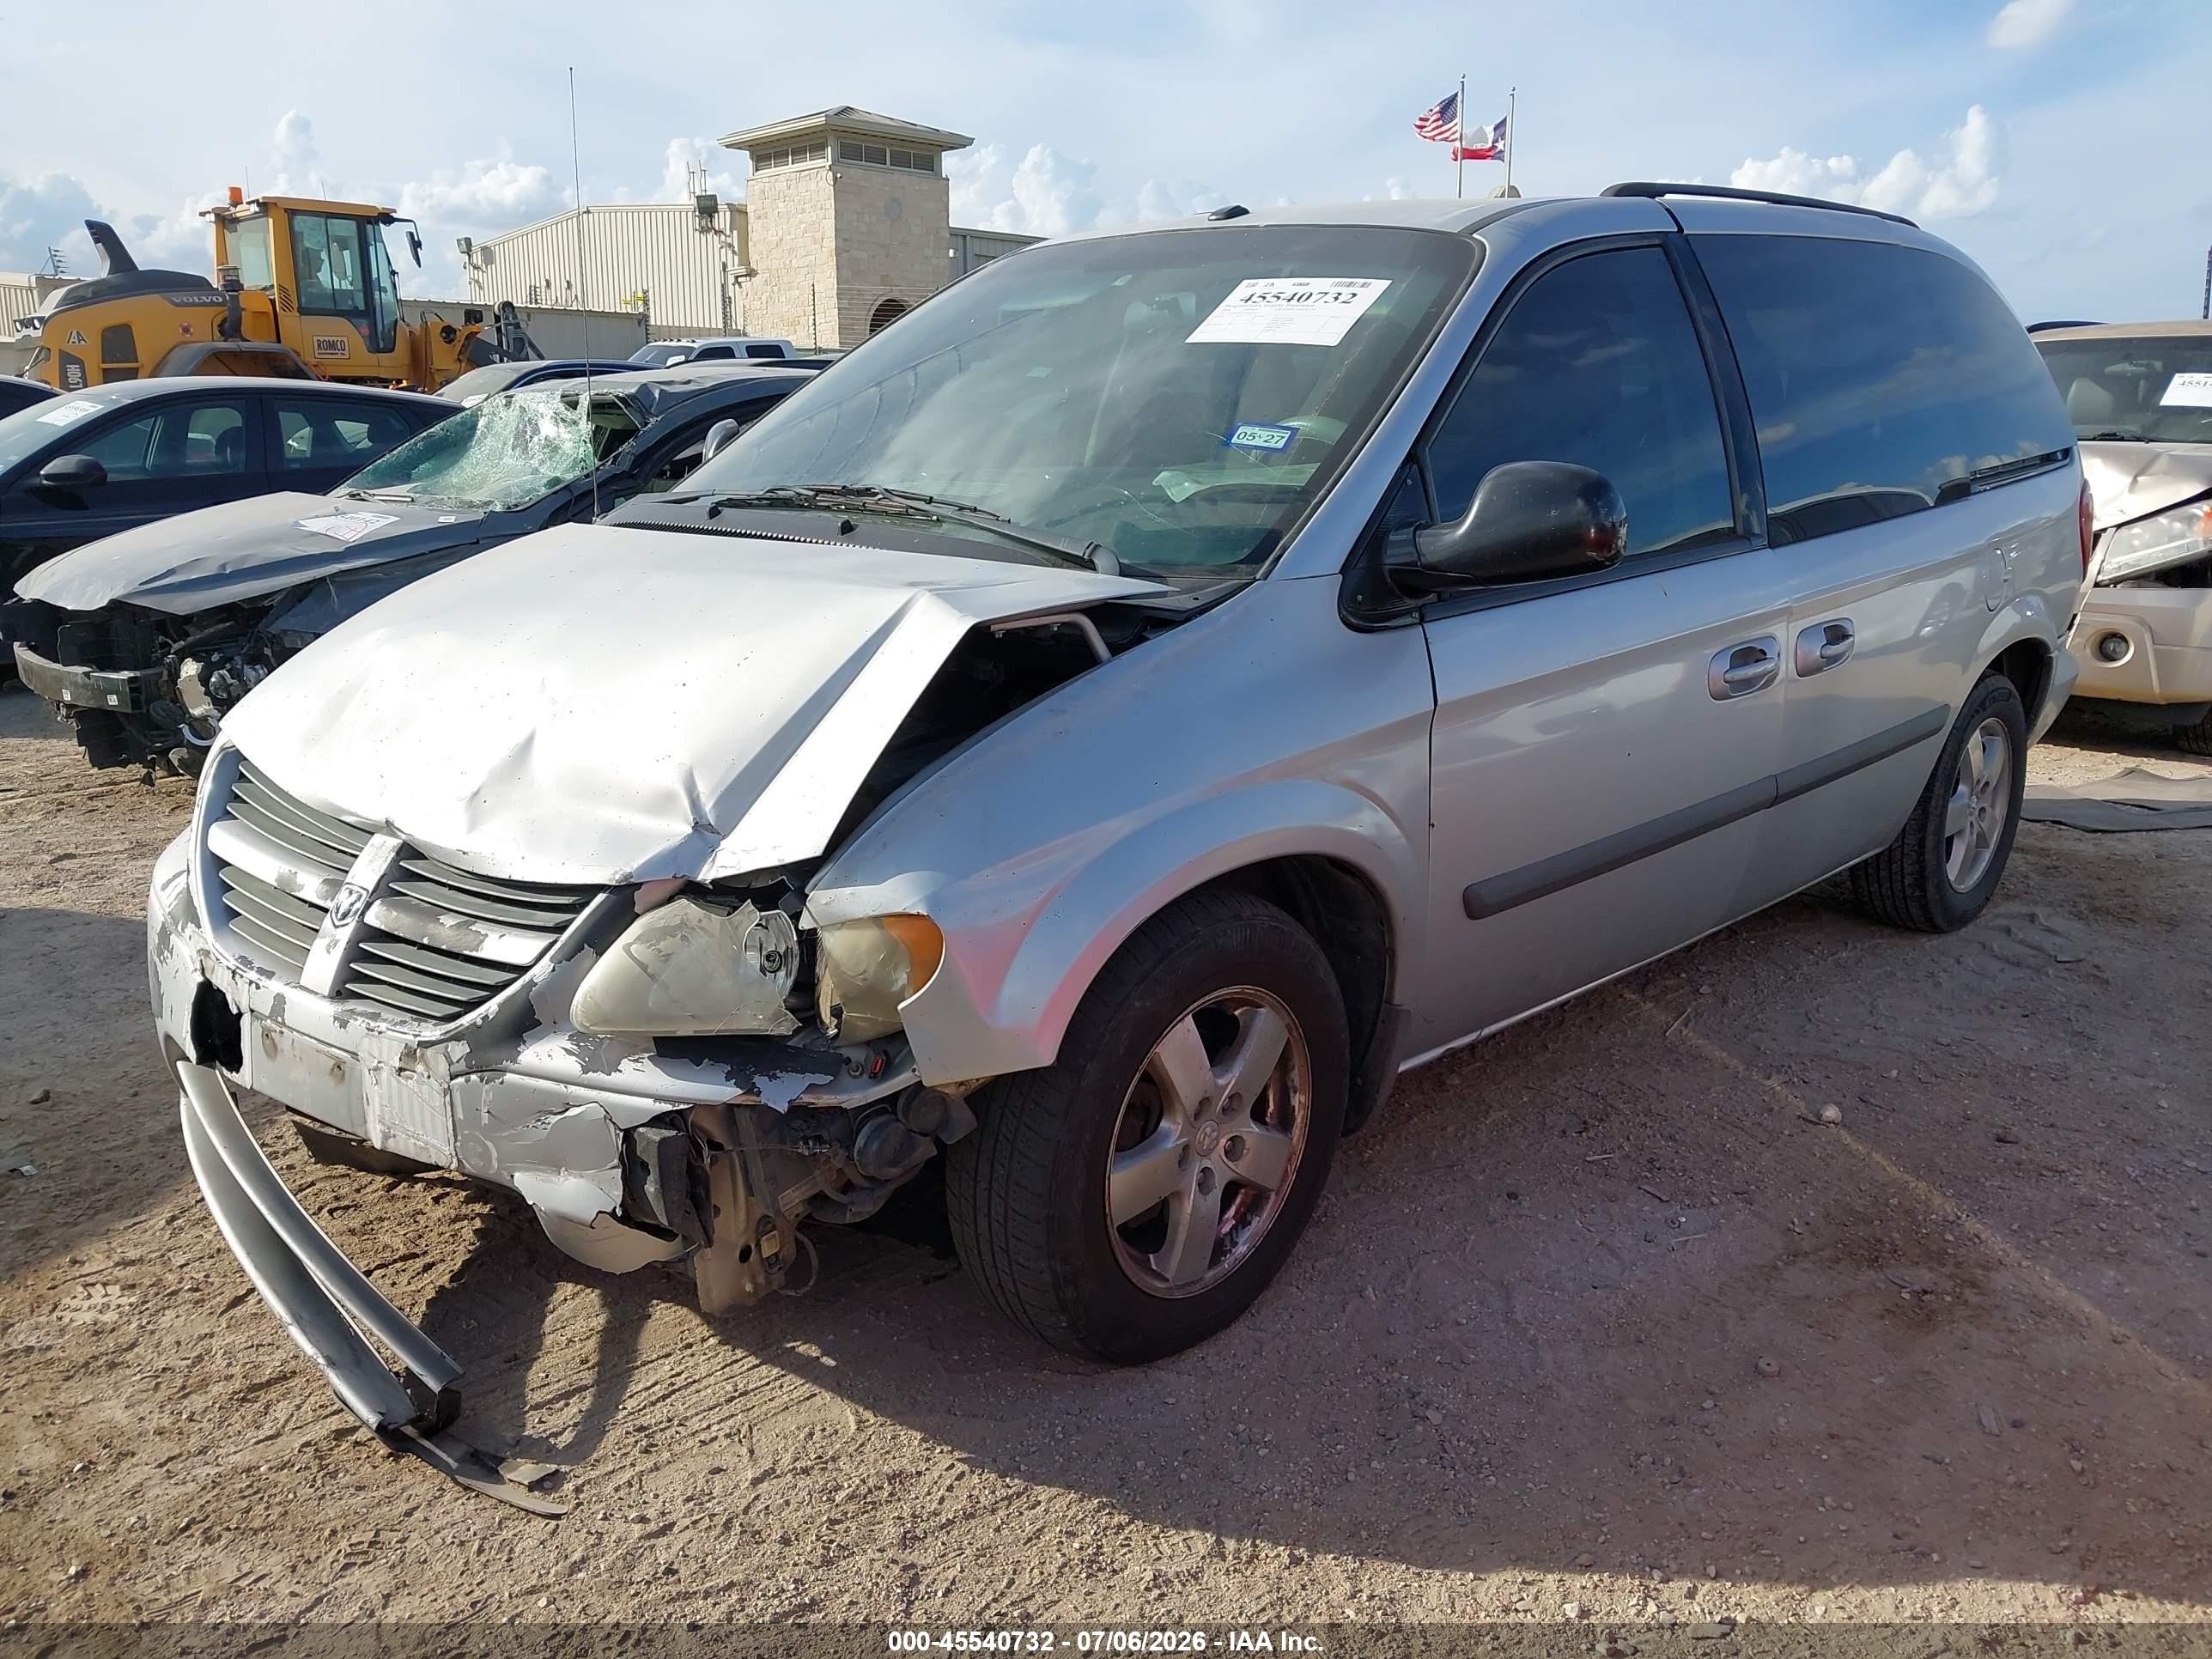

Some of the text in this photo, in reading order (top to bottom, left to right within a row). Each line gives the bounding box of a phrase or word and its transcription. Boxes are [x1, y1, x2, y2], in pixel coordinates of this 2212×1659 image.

[1240, 291, 1358, 304] 45540732
[316, 338, 346, 352] ROMCO
[66, 364, 83, 388] L90H
